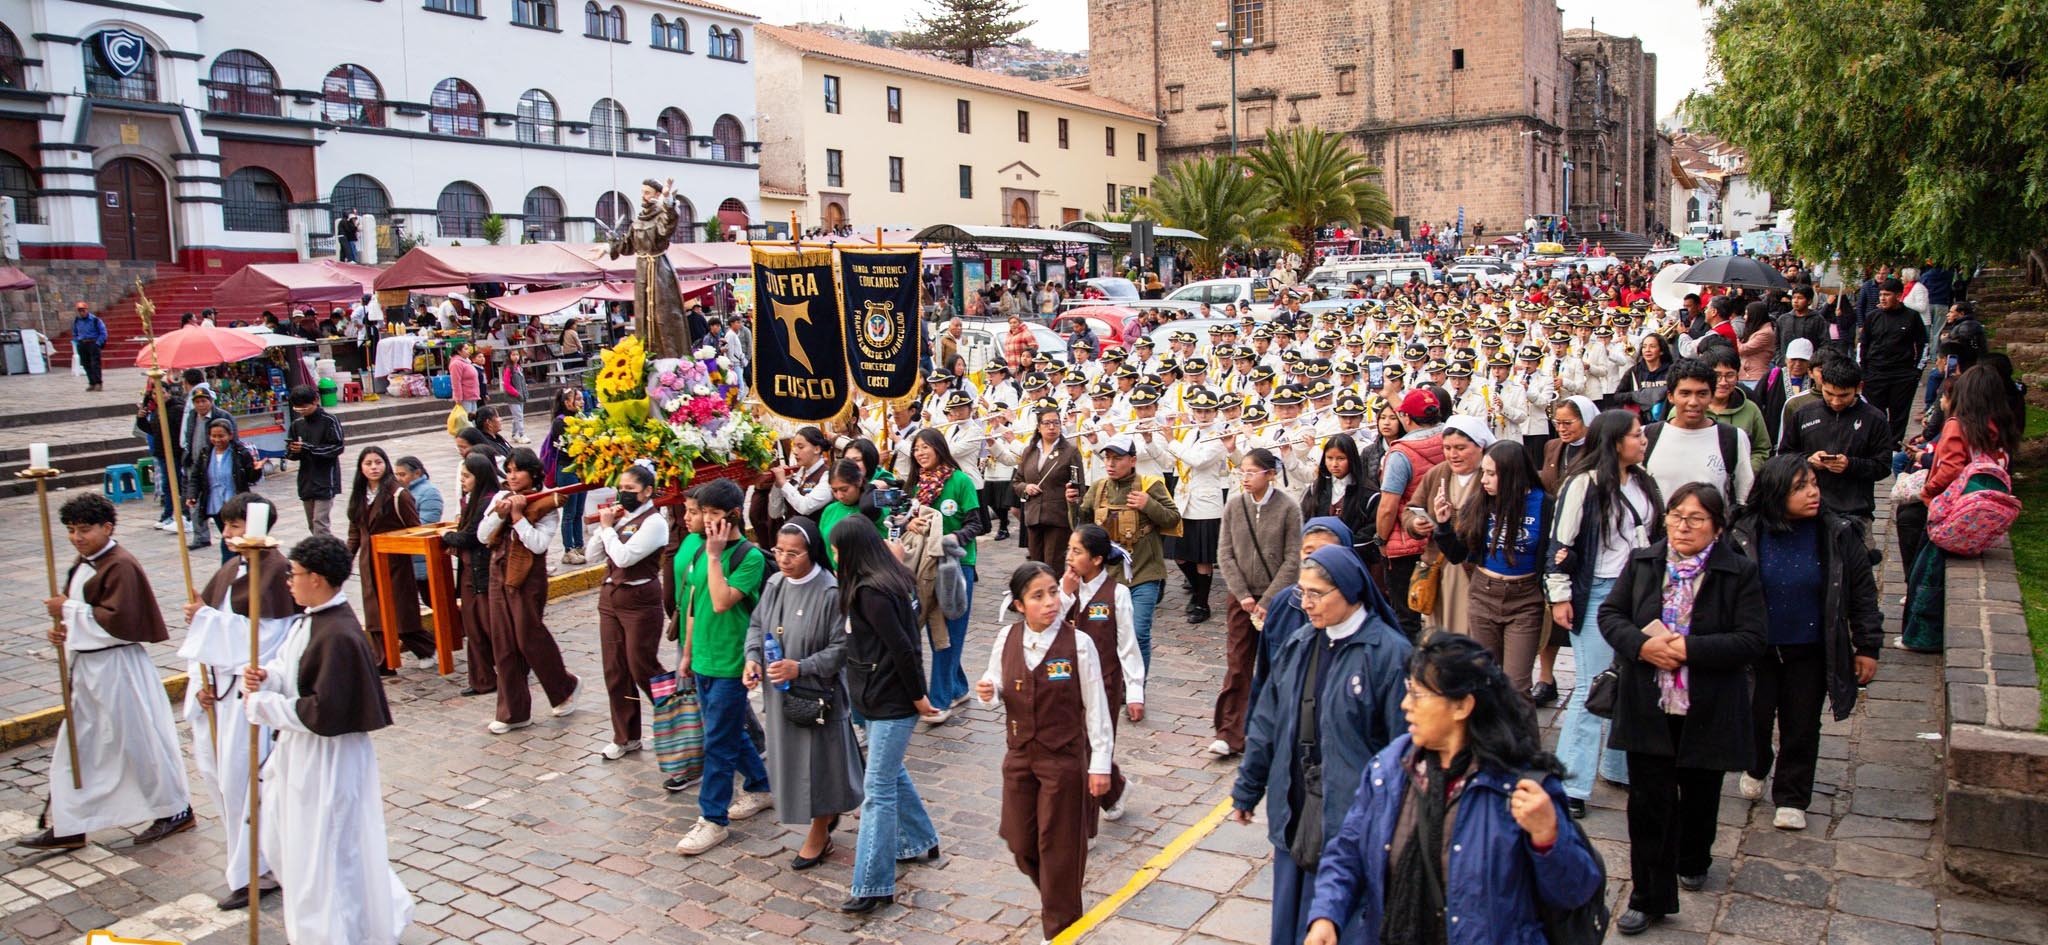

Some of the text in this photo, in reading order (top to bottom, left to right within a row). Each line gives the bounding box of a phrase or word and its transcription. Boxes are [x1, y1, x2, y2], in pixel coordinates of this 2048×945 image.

[872, 265, 907, 275] SINFONICA
[764, 271, 819, 297] JUFRA
[859, 275, 900, 289] EDUCANDAS
[860, 361, 896, 372] CONCEPCION
[774, 374, 836, 400] CUSCO
[867, 375, 889, 388] CUSCO
